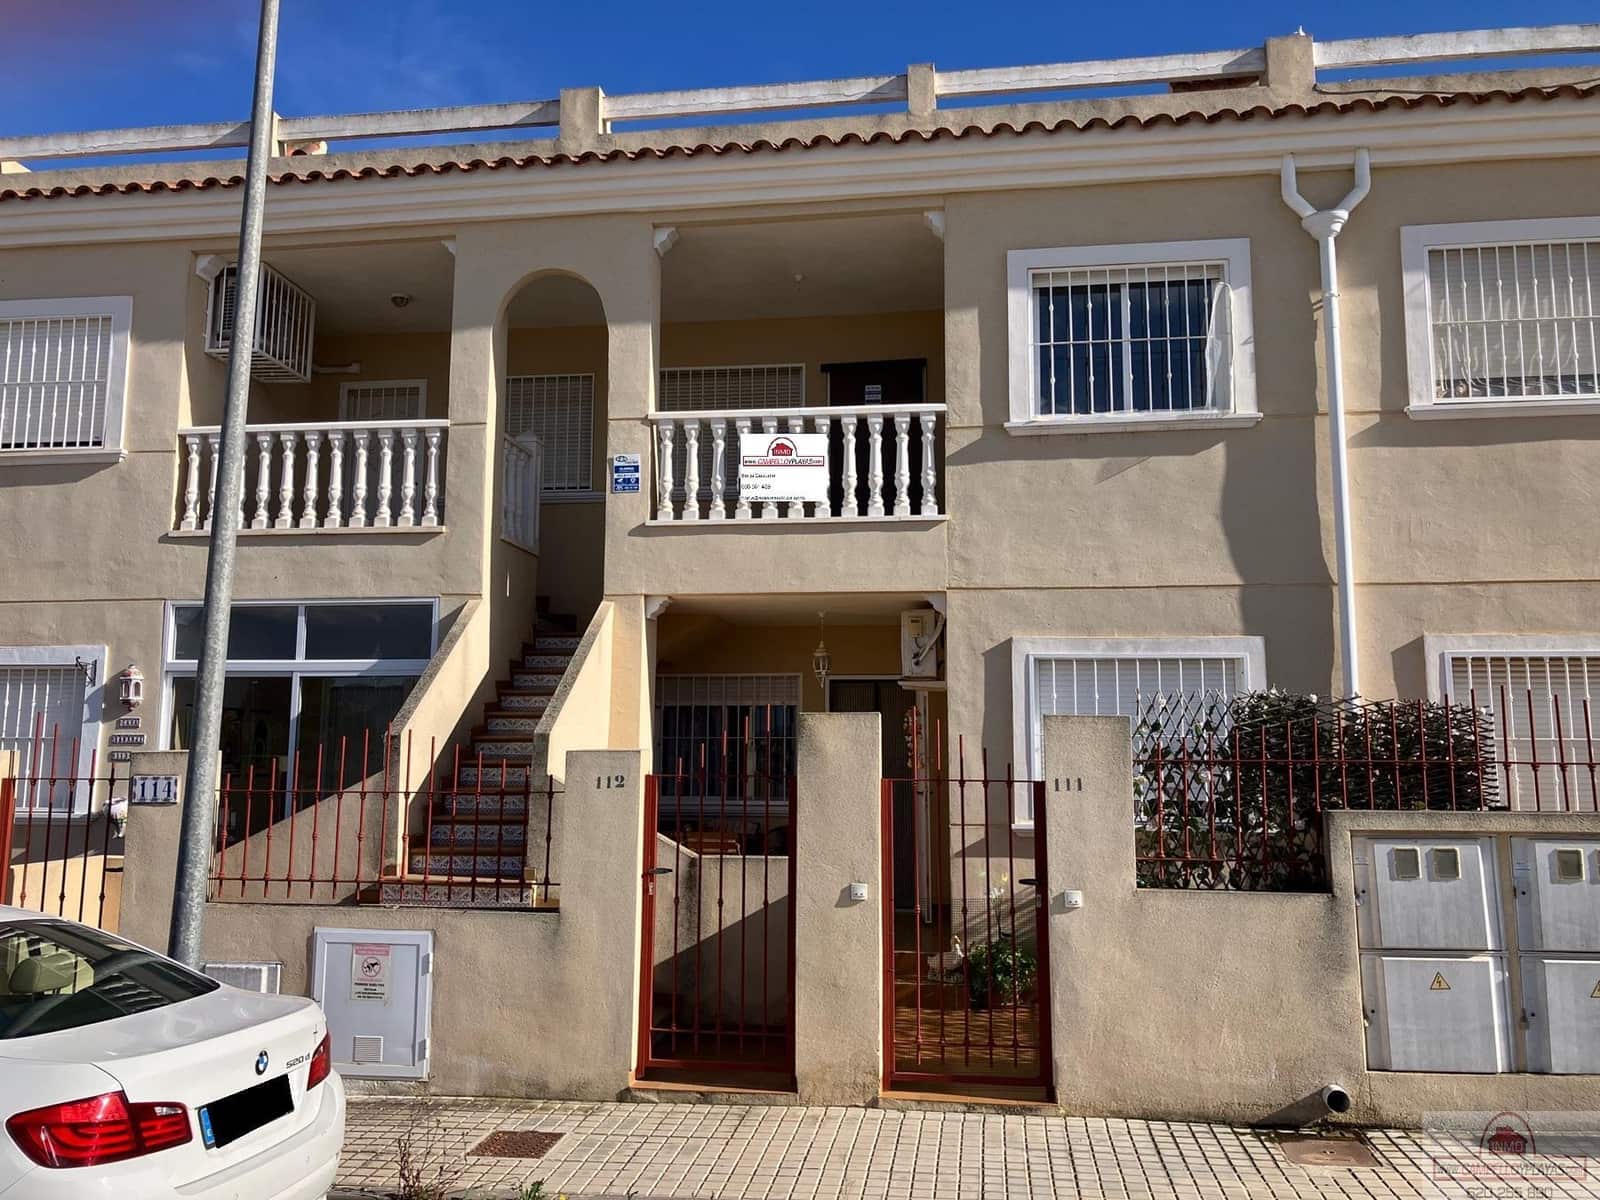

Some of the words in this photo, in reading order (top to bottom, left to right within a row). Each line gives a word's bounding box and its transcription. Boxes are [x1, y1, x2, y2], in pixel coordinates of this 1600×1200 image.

[140, 780, 172, 798] 114
[596, 775, 625, 789] 112
[1055, 777, 1082, 791] 111
